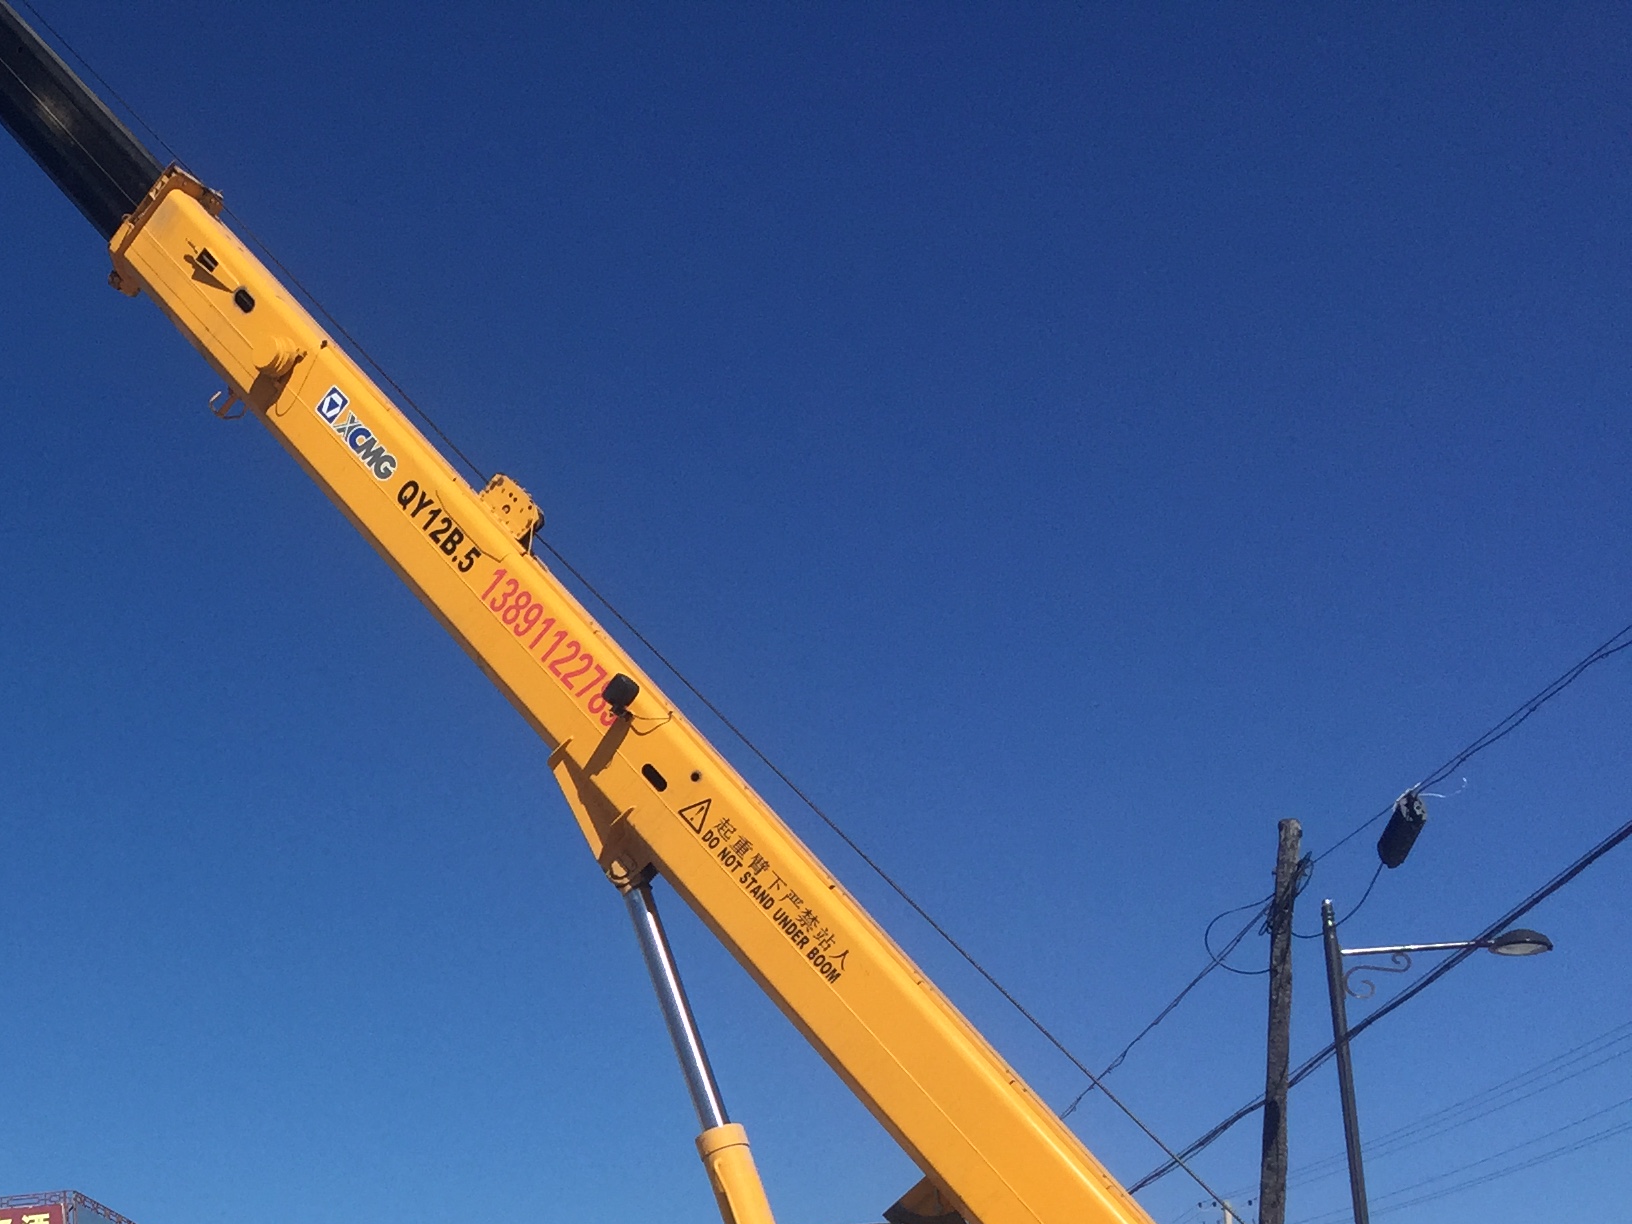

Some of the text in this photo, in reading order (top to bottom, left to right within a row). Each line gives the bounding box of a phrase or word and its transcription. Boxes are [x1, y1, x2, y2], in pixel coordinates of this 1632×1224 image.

[333, 410, 398, 481] XCMG
[397, 480, 481, 573] QY12B.5
[701, 829, 841, 984] DO NOT STAND UNDER BOOM
[713, 817, 849, 971] 起重臂下严禁站人
